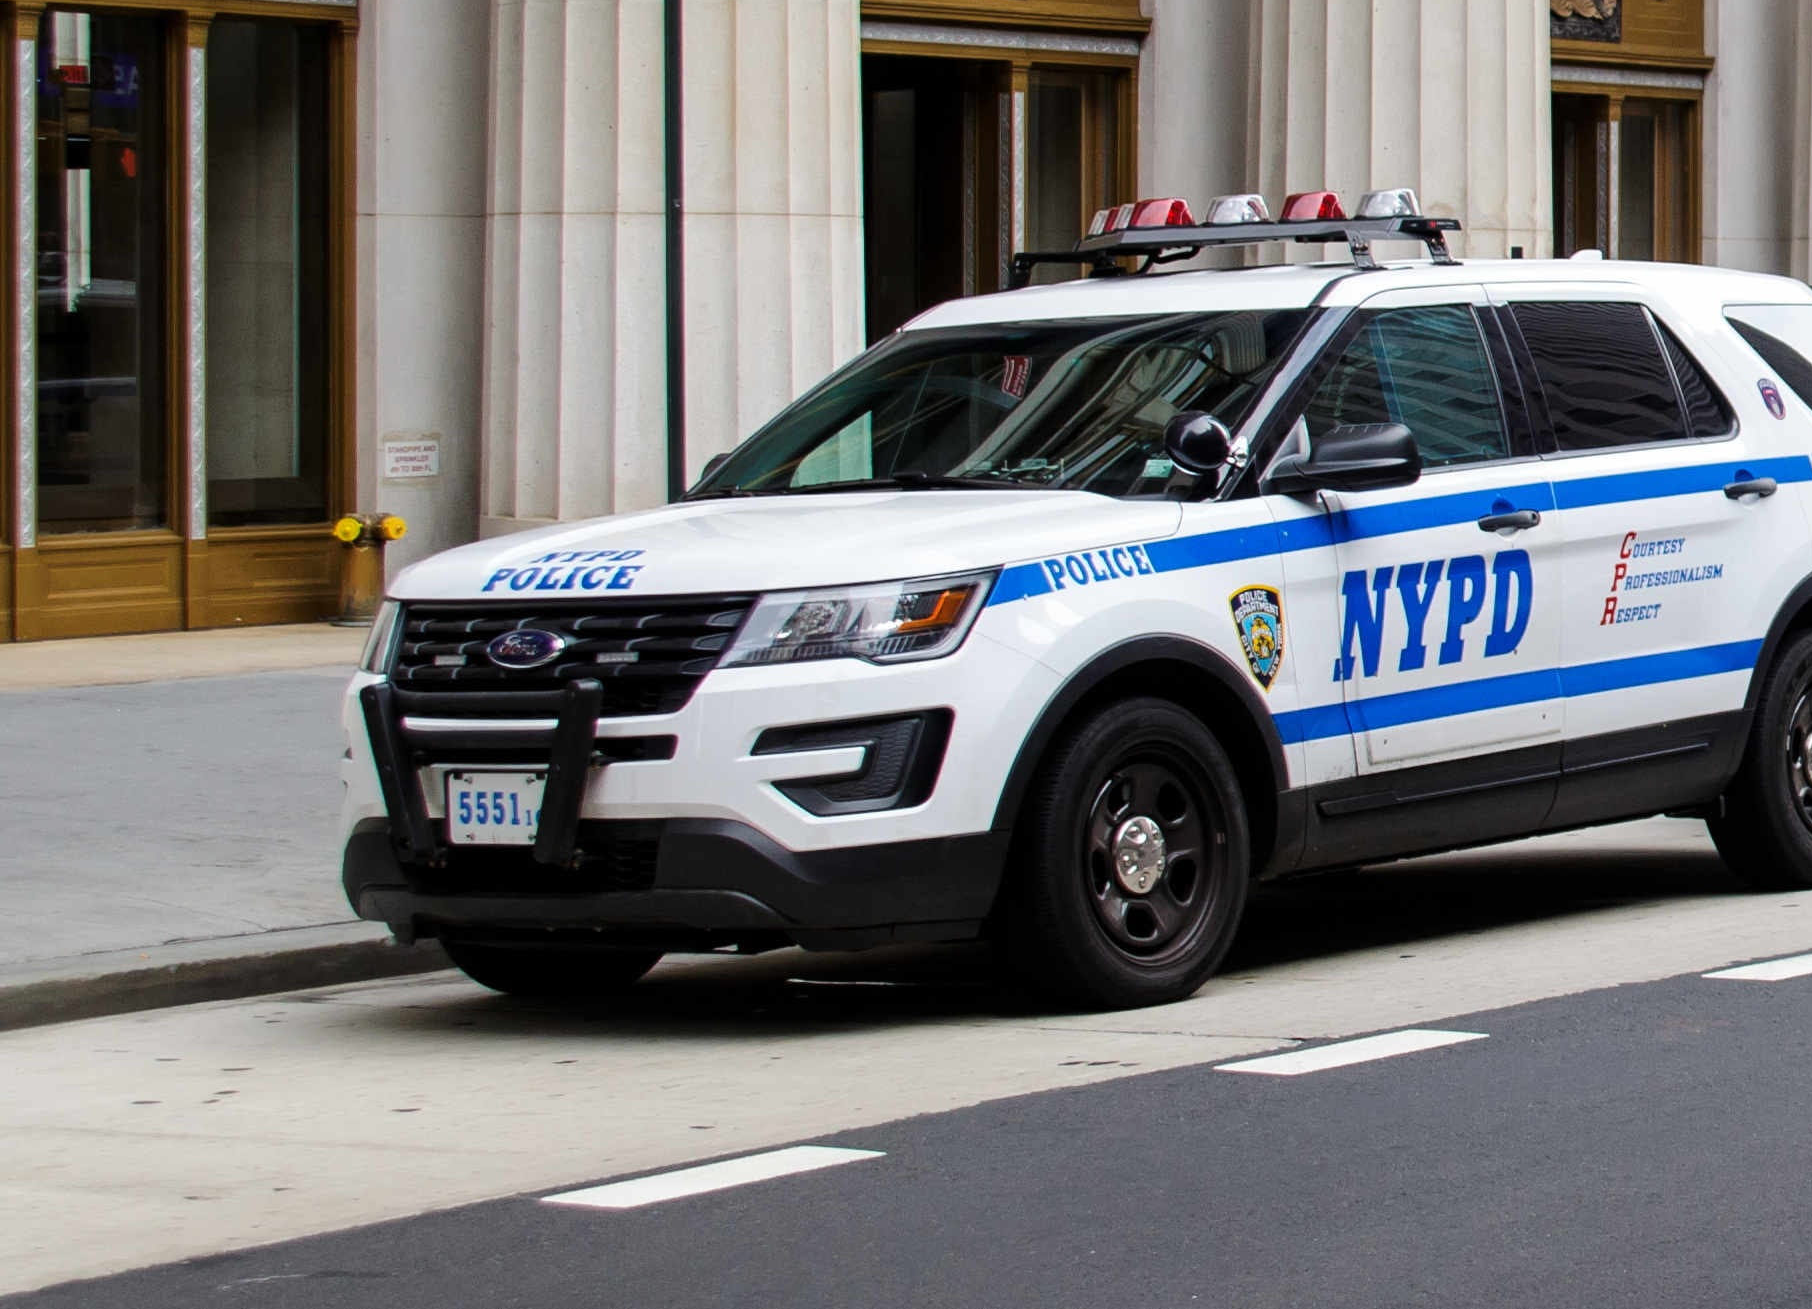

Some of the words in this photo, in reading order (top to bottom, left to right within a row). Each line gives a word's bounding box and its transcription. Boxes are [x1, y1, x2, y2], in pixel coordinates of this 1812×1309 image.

[529, 549, 647, 564] NYPD
[1620, 531, 1686, 560] COURTESY
[481, 565, 646, 592] POLICE
[1043, 544, 1154, 591] POLICE
[1611, 562, 1723, 592] PROFESSIONALISM
[1239, 589, 1268, 605] POLICE
[1600, 596, 1662, 626] RESPECT
[1332, 548, 1534, 683] NYPD
[459, 791, 521, 826] 5551
